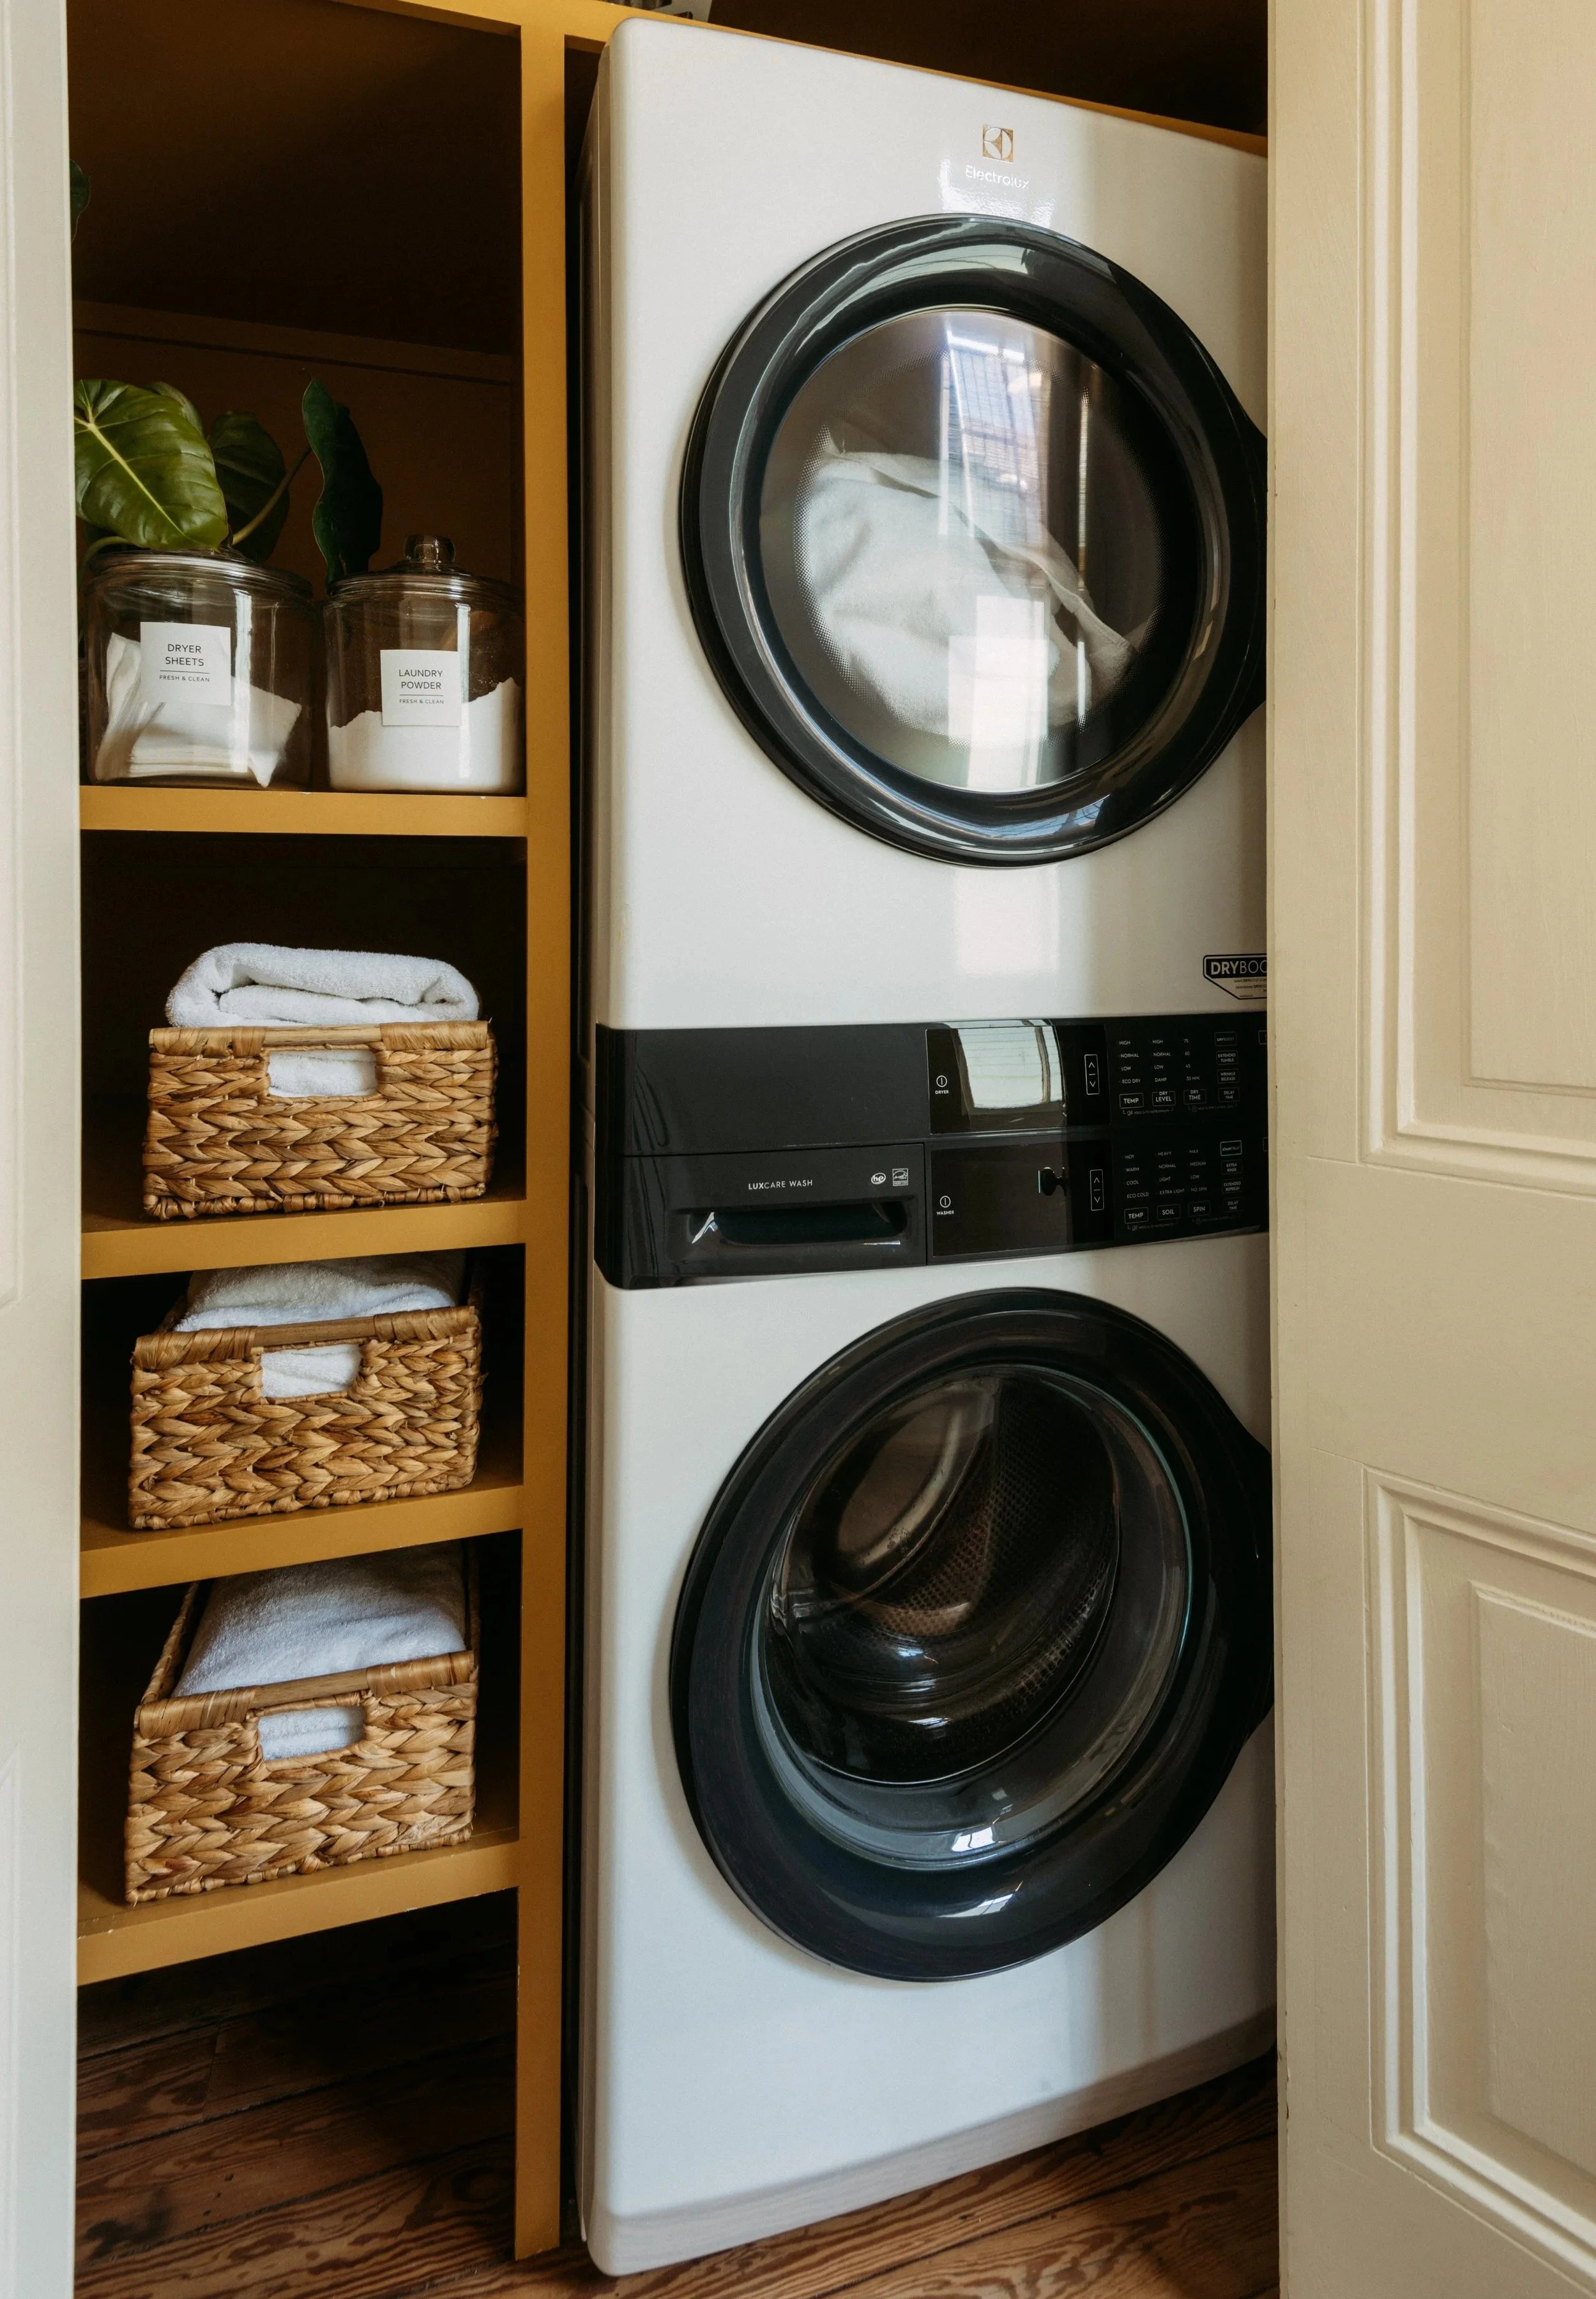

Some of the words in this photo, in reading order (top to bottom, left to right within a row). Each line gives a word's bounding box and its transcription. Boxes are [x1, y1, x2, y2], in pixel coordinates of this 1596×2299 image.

[966, 165, 1029, 189] Electrolux
[167, 644, 201, 653] DRYER
[165, 656, 204, 666] SHEETS
[749, 1181, 786, 1190] LUXCARE
